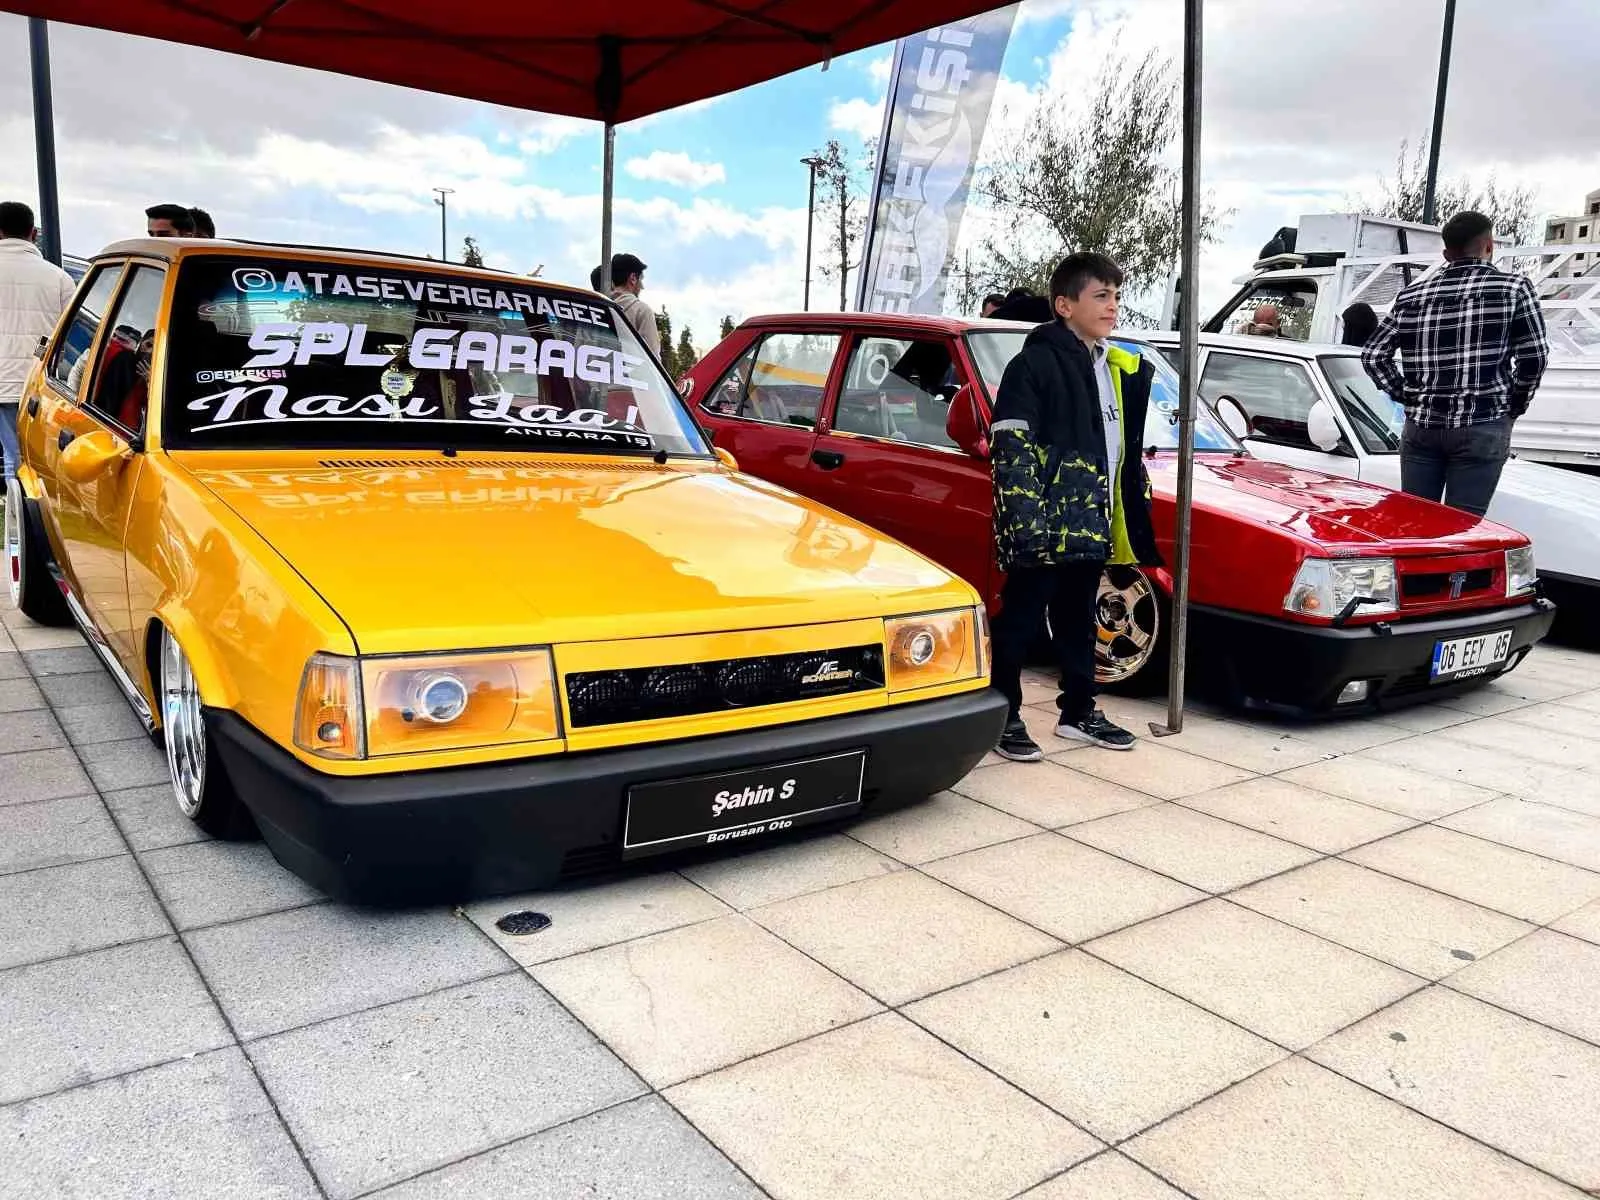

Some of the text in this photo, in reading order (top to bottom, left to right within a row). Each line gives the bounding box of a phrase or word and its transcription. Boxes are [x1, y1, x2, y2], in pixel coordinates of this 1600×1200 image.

[283, 272, 610, 328] ATASEVERGARAGEE
[241, 322, 649, 391] SPL GARAGE
[505, 427, 617, 443] ANGARA
[1441, 643, 1456, 671] 06
[1462, 638, 1486, 666] EEY
[1493, 633, 1510, 660] 85
[711, 779, 797, 817] Şahin S
[706, 819, 793, 844] Borusan Oto
